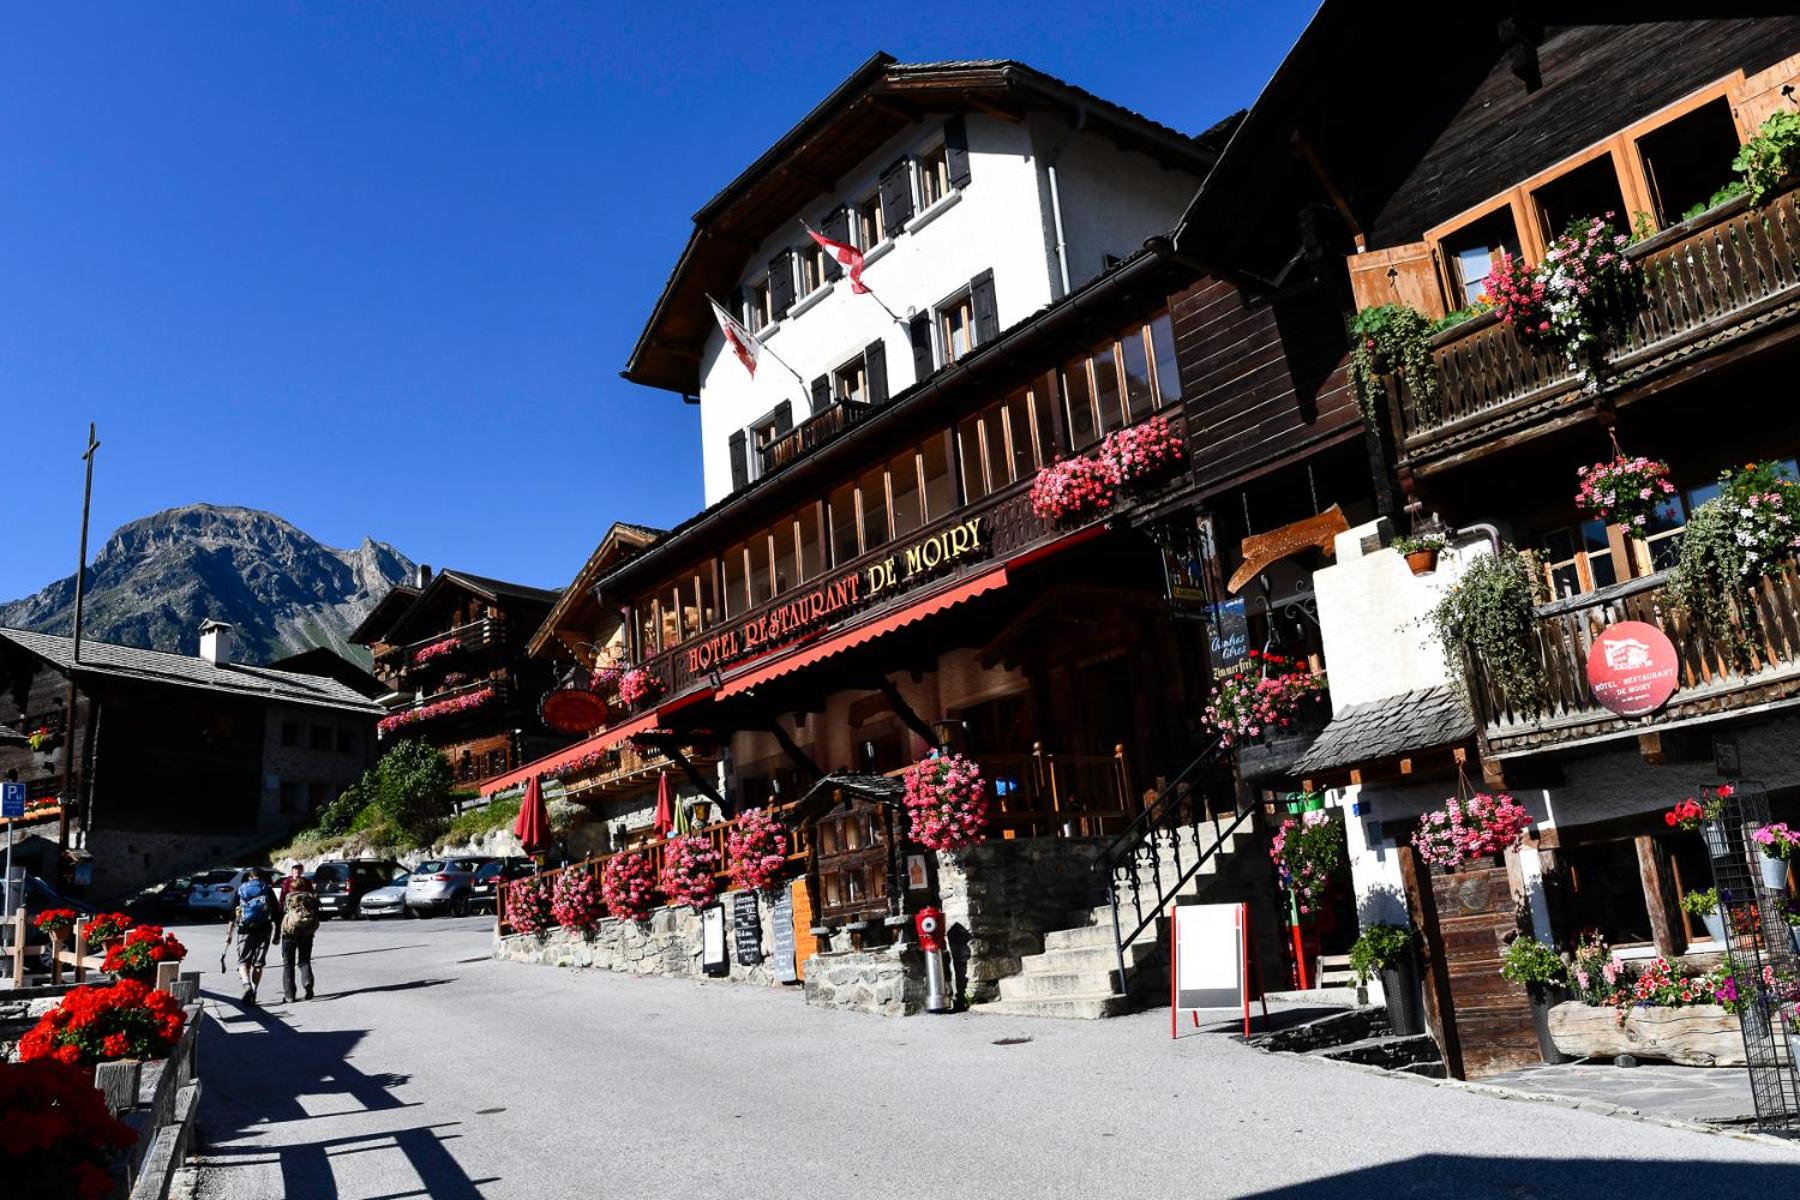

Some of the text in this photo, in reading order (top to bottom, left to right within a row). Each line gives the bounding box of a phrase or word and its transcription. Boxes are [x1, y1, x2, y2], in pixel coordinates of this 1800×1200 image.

[689, 517, 981, 672] HOTEL RESTAURANT DE MOIRY
[1623, 668, 1673, 685] RESTAURANT
[1629, 682, 1652, 694] MOIRY
[7, 785, 17, 800] P
